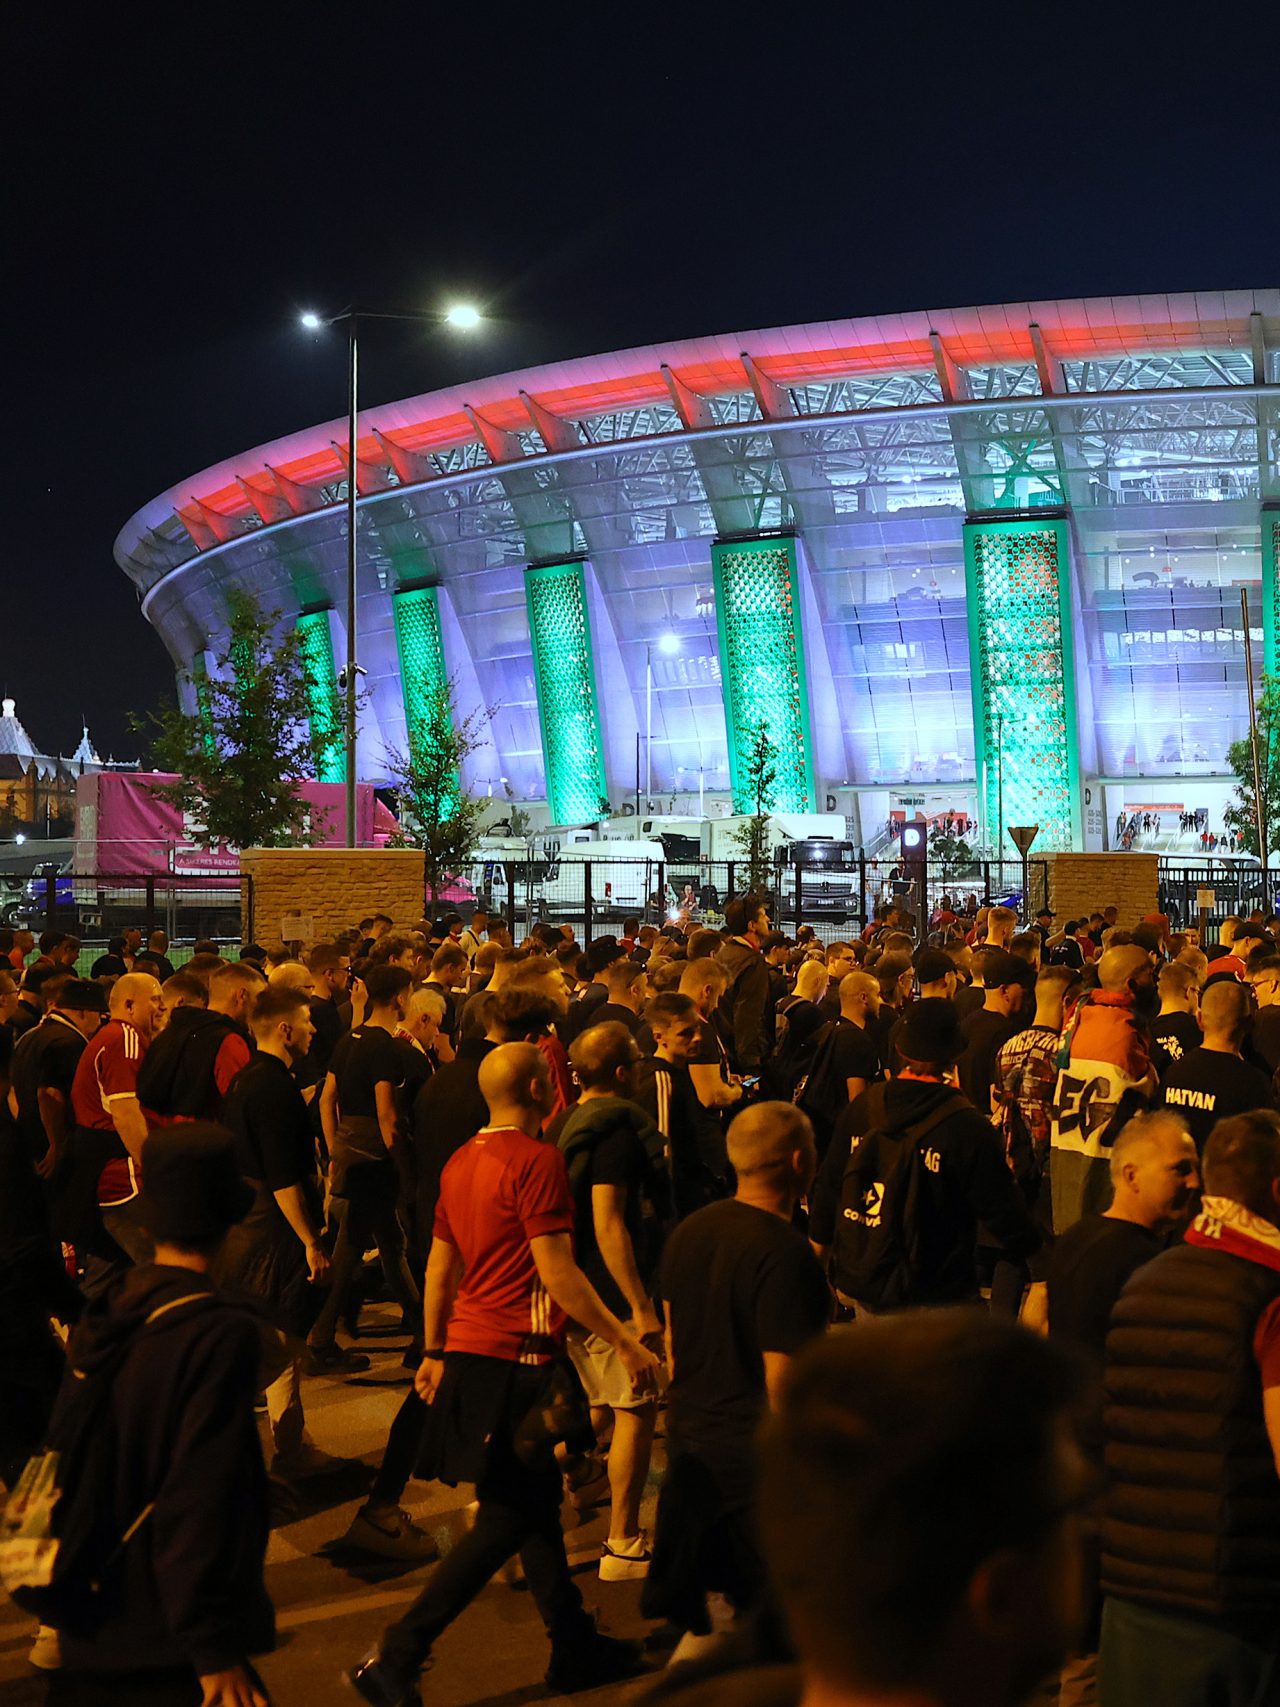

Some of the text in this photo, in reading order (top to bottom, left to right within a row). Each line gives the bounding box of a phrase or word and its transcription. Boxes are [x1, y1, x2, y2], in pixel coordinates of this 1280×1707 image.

[826, 794, 837, 811] D
[904, 828, 920, 847] D
[1165, 1087, 1216, 1111] HATVAN
